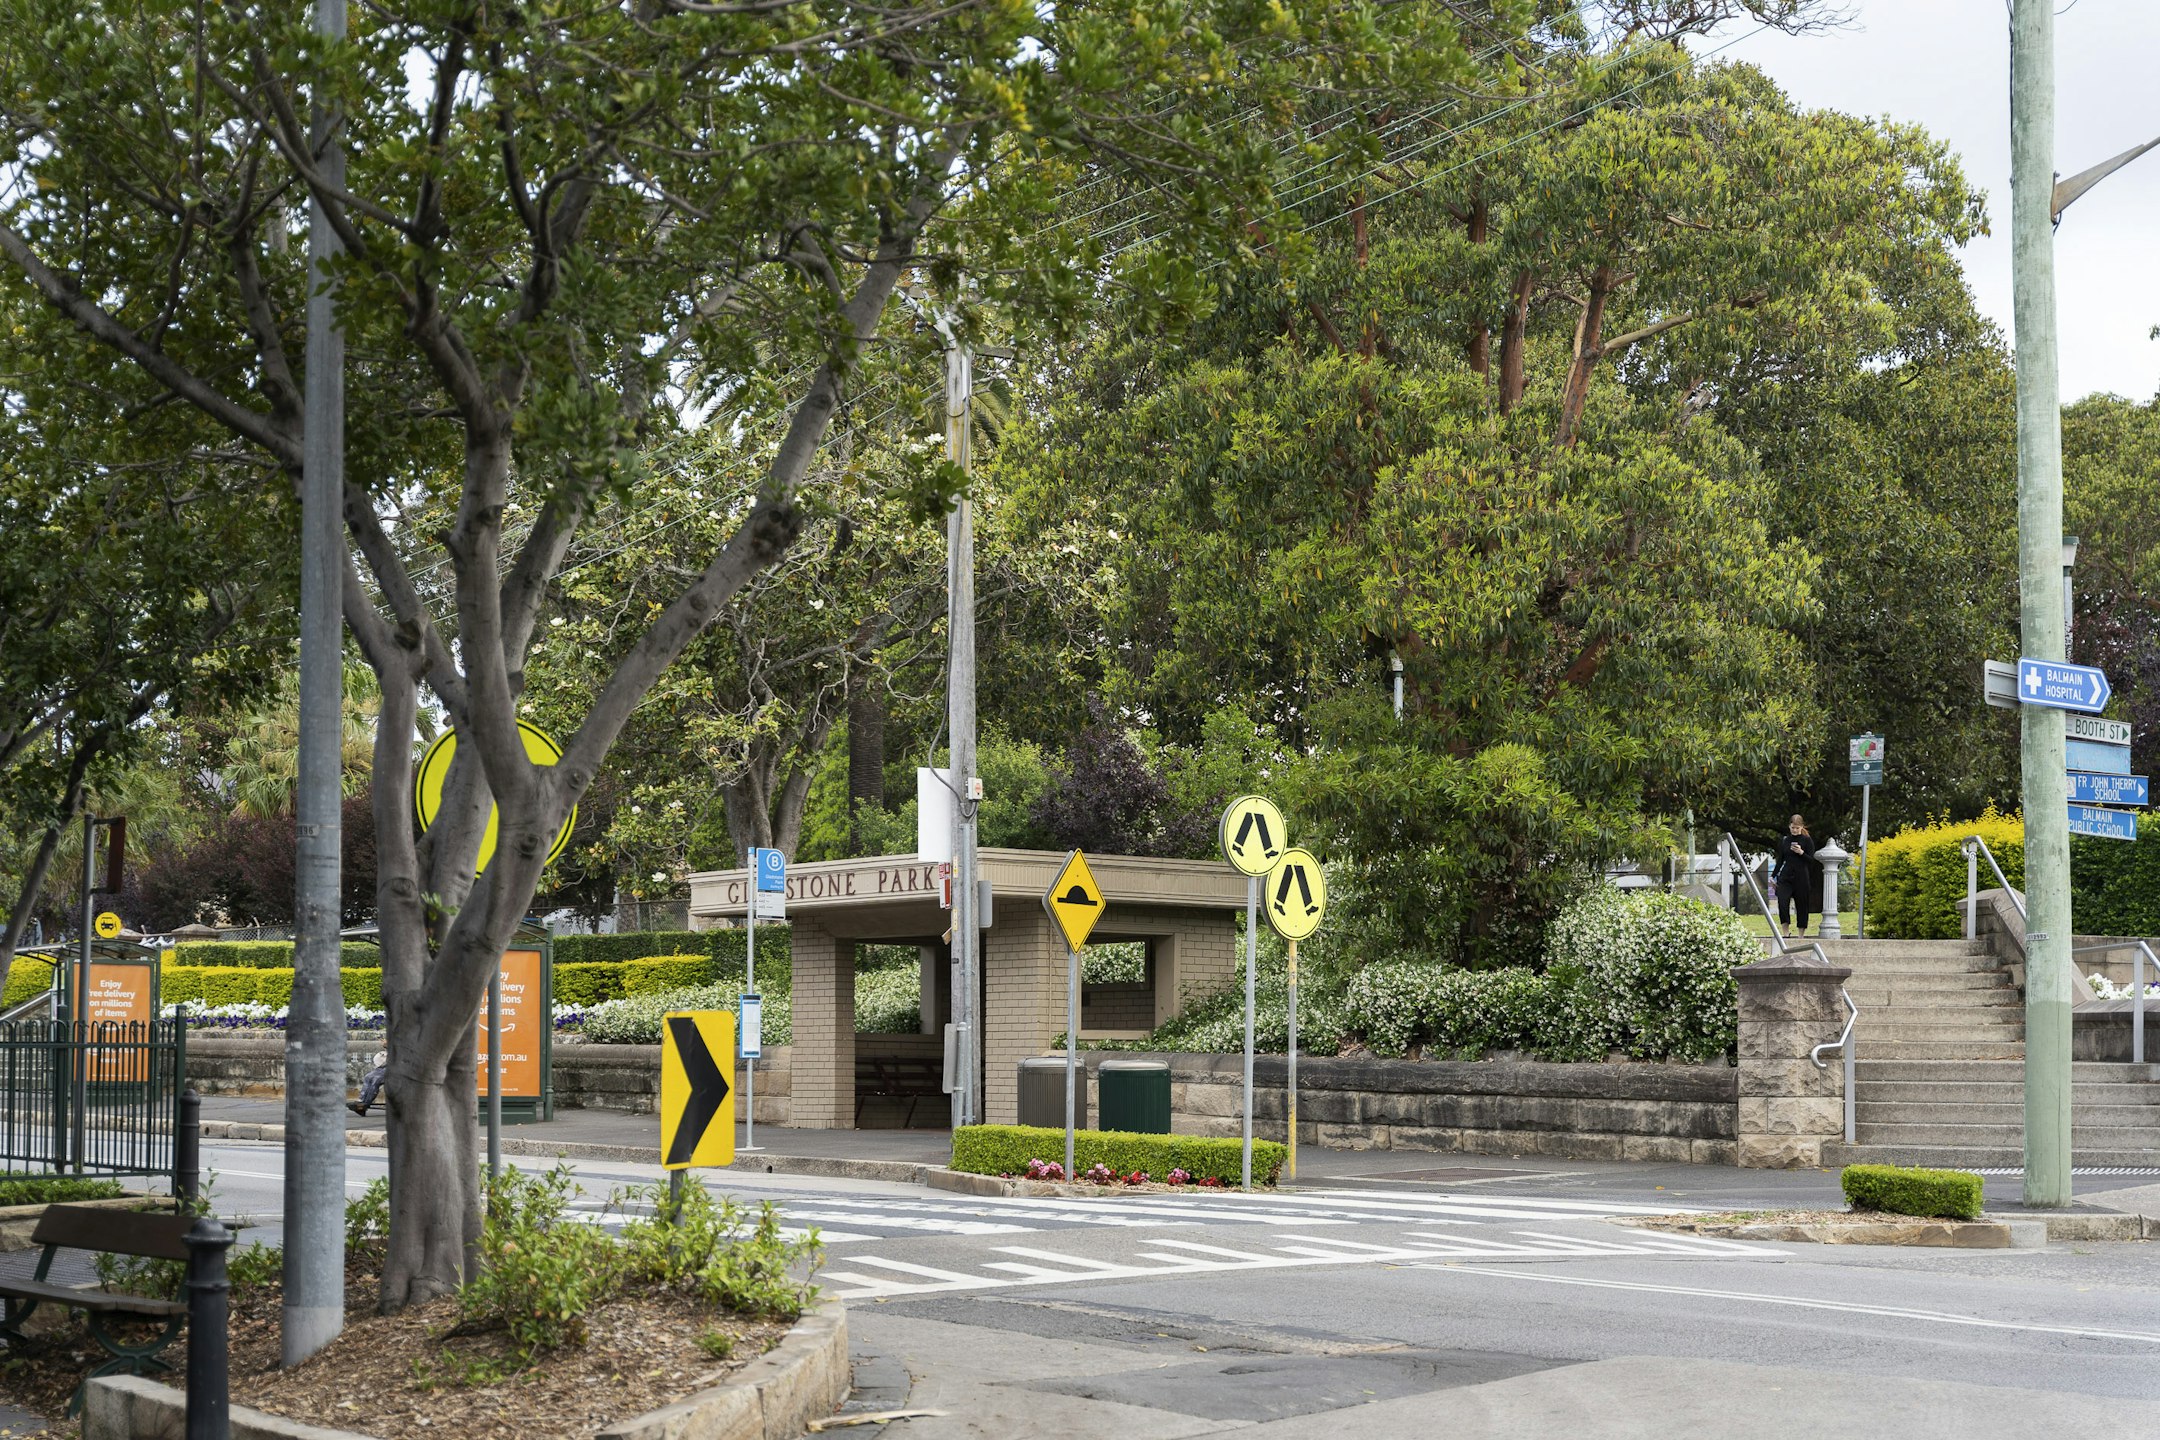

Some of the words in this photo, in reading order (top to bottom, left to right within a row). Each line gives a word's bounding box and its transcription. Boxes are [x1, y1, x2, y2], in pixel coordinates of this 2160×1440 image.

[2046, 669, 2083, 686] BALMAIN
[2045, 685, 2084, 701] HOSPITAL
[2075, 718, 2105, 738] BOOTH
[2109, 724, 2121, 740] ST
[2077, 775, 2087, 788] FR
[2090, 776, 2109, 789] JOHN
[2111, 778, 2137, 790] THERRY
[2094, 788, 2122, 801] SCHOOL
[2082, 808, 2113, 823] BALMAIN
[2069, 820, 2093, 834] PUBLIC
[2097, 823, 2125, 837] SCHOOL
[771, 856, 779, 867] B
[728, 872, 856, 904] GLSTONE
[878, 866, 935, 893] PARK
[100, 980, 122, 989] Enjoy
[500, 981, 524, 994] livery
[104, 990, 135, 999] delivery
[94, 1009, 104, 1017] of
[105, 1009, 127, 1017] items
